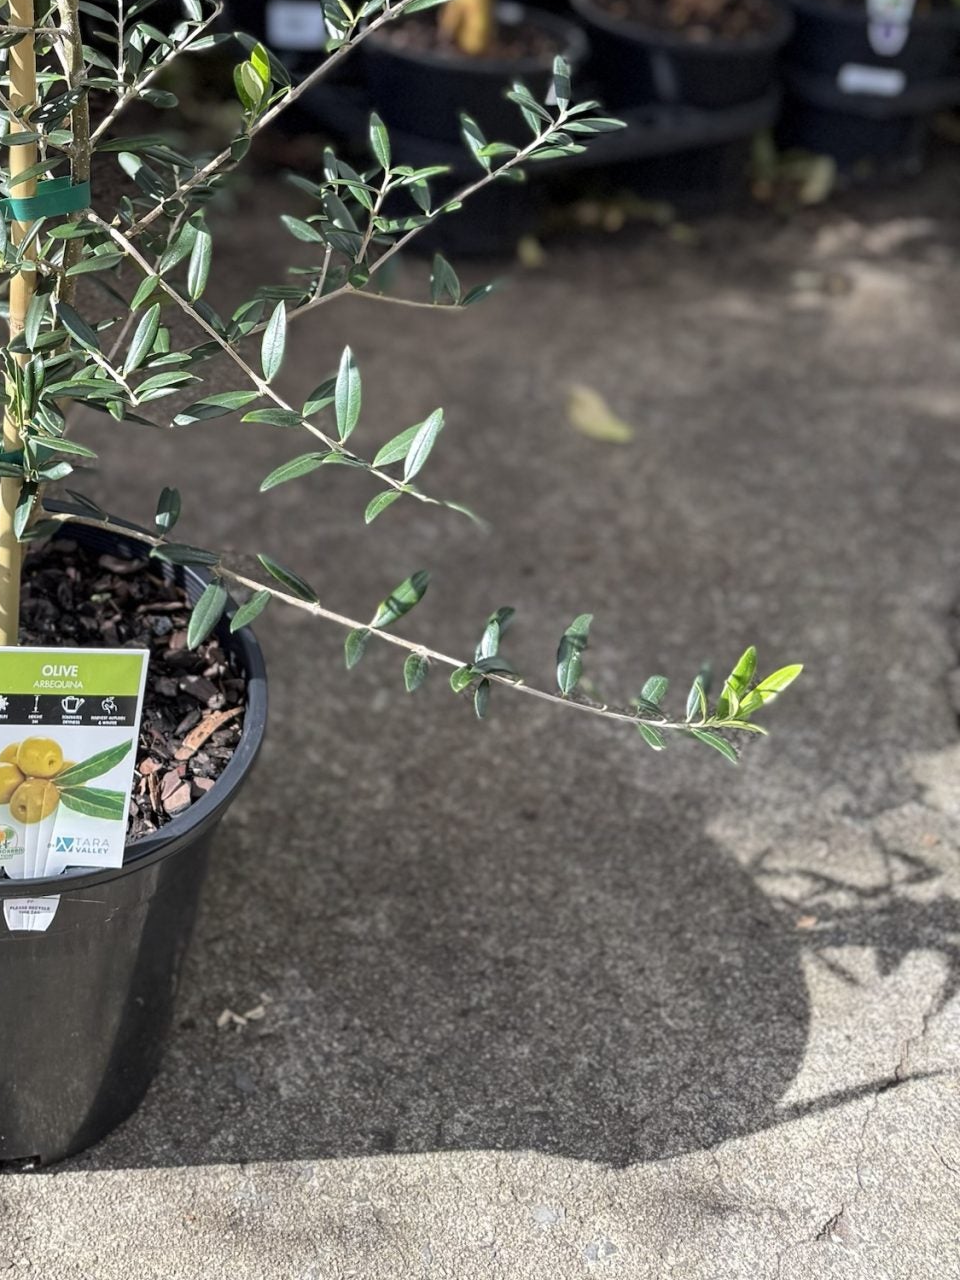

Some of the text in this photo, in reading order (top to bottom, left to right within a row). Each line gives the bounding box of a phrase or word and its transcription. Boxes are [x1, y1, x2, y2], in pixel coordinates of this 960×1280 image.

[42, 664, 78, 677] OLIVE
[33, 680, 83, 689] ARBEQUINA
[76, 838, 110, 846] TARA
